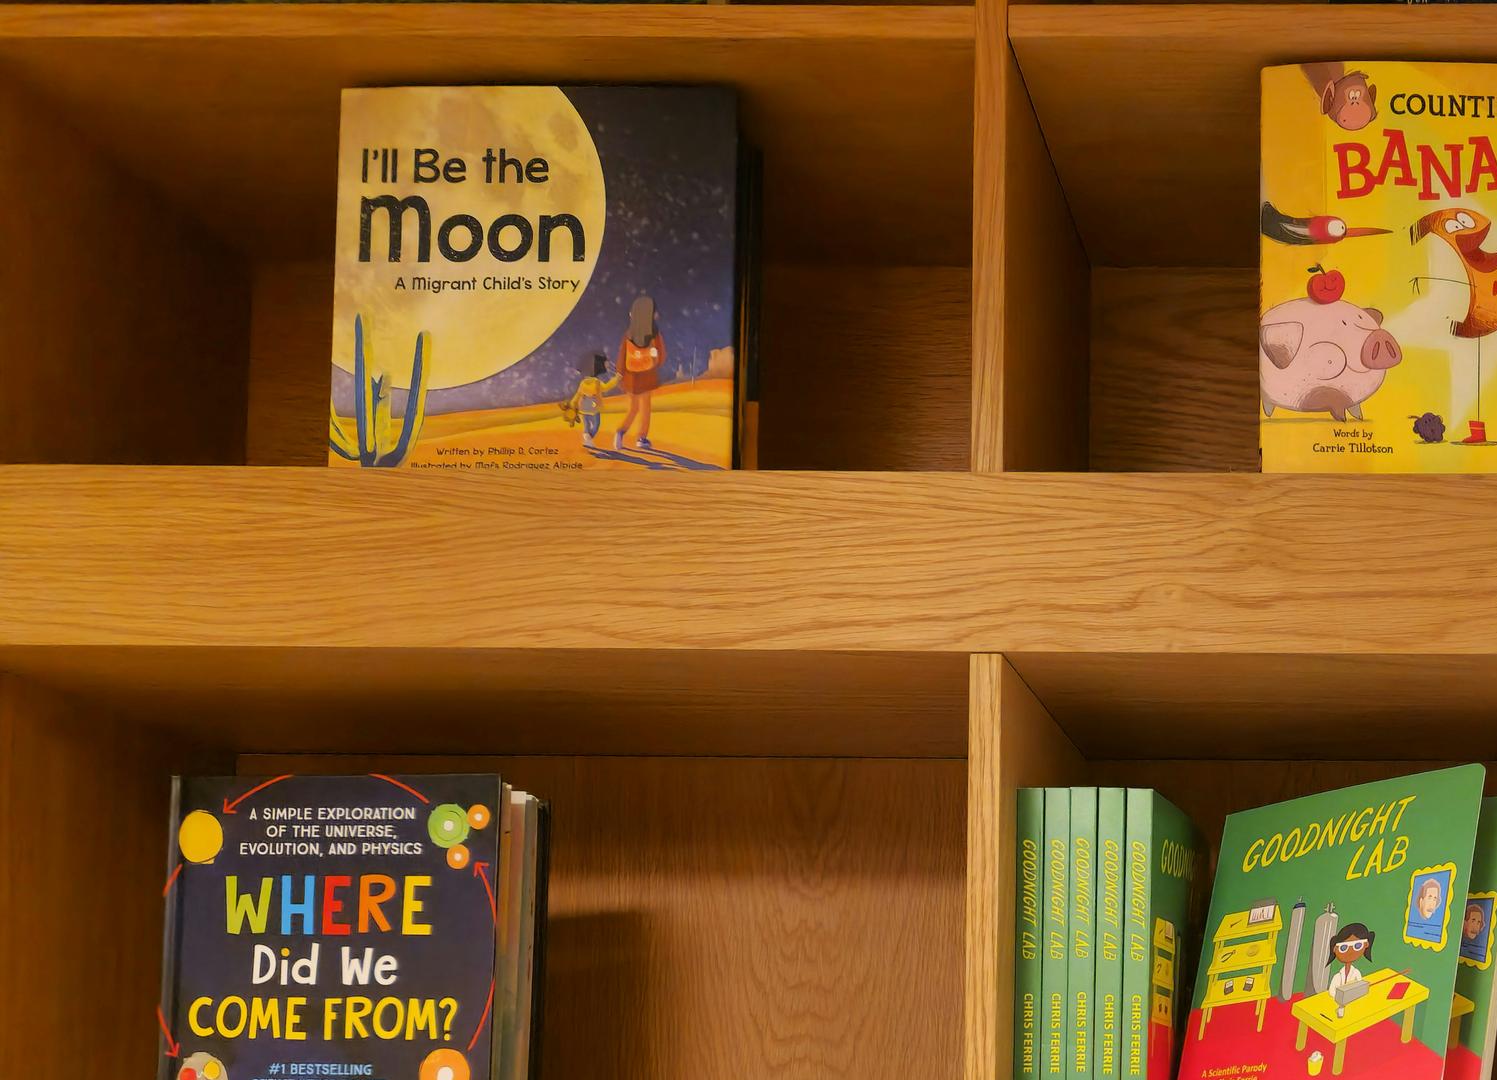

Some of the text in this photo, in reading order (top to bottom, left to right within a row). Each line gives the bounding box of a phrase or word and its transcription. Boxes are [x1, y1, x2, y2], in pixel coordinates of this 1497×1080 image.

[361, 148, 549, 183] I'll Be the
[359, 195, 586, 263] Moon
[395, 276, 579, 293] A Migrant Child's Story
[1313, 442, 1394, 454] Carrie Tillotson
[250, 807, 415, 820] A SIMPLE EXPLORATION
[267, 825, 398, 839] OF THE UNIVERSE,
[1242, 796, 1417, 880] GOODNIGHT LAB
[240, 843, 422, 857] EVOLUTION, AND PHYSICS
[225, 874, 432, 935] WHERE
[1022, 839, 1039, 960] GOODNIGHT LAB
[252, 943, 398, 985] Did We
[188, 996, 458, 1041] COME FROM?
[1023, 994, 1033, 1074] CHRIS FERRIE
[269, 1064, 372, 1075] #1 BESTSELLING
[1202, 1062, 1267, 1078] A Scientific Parody
